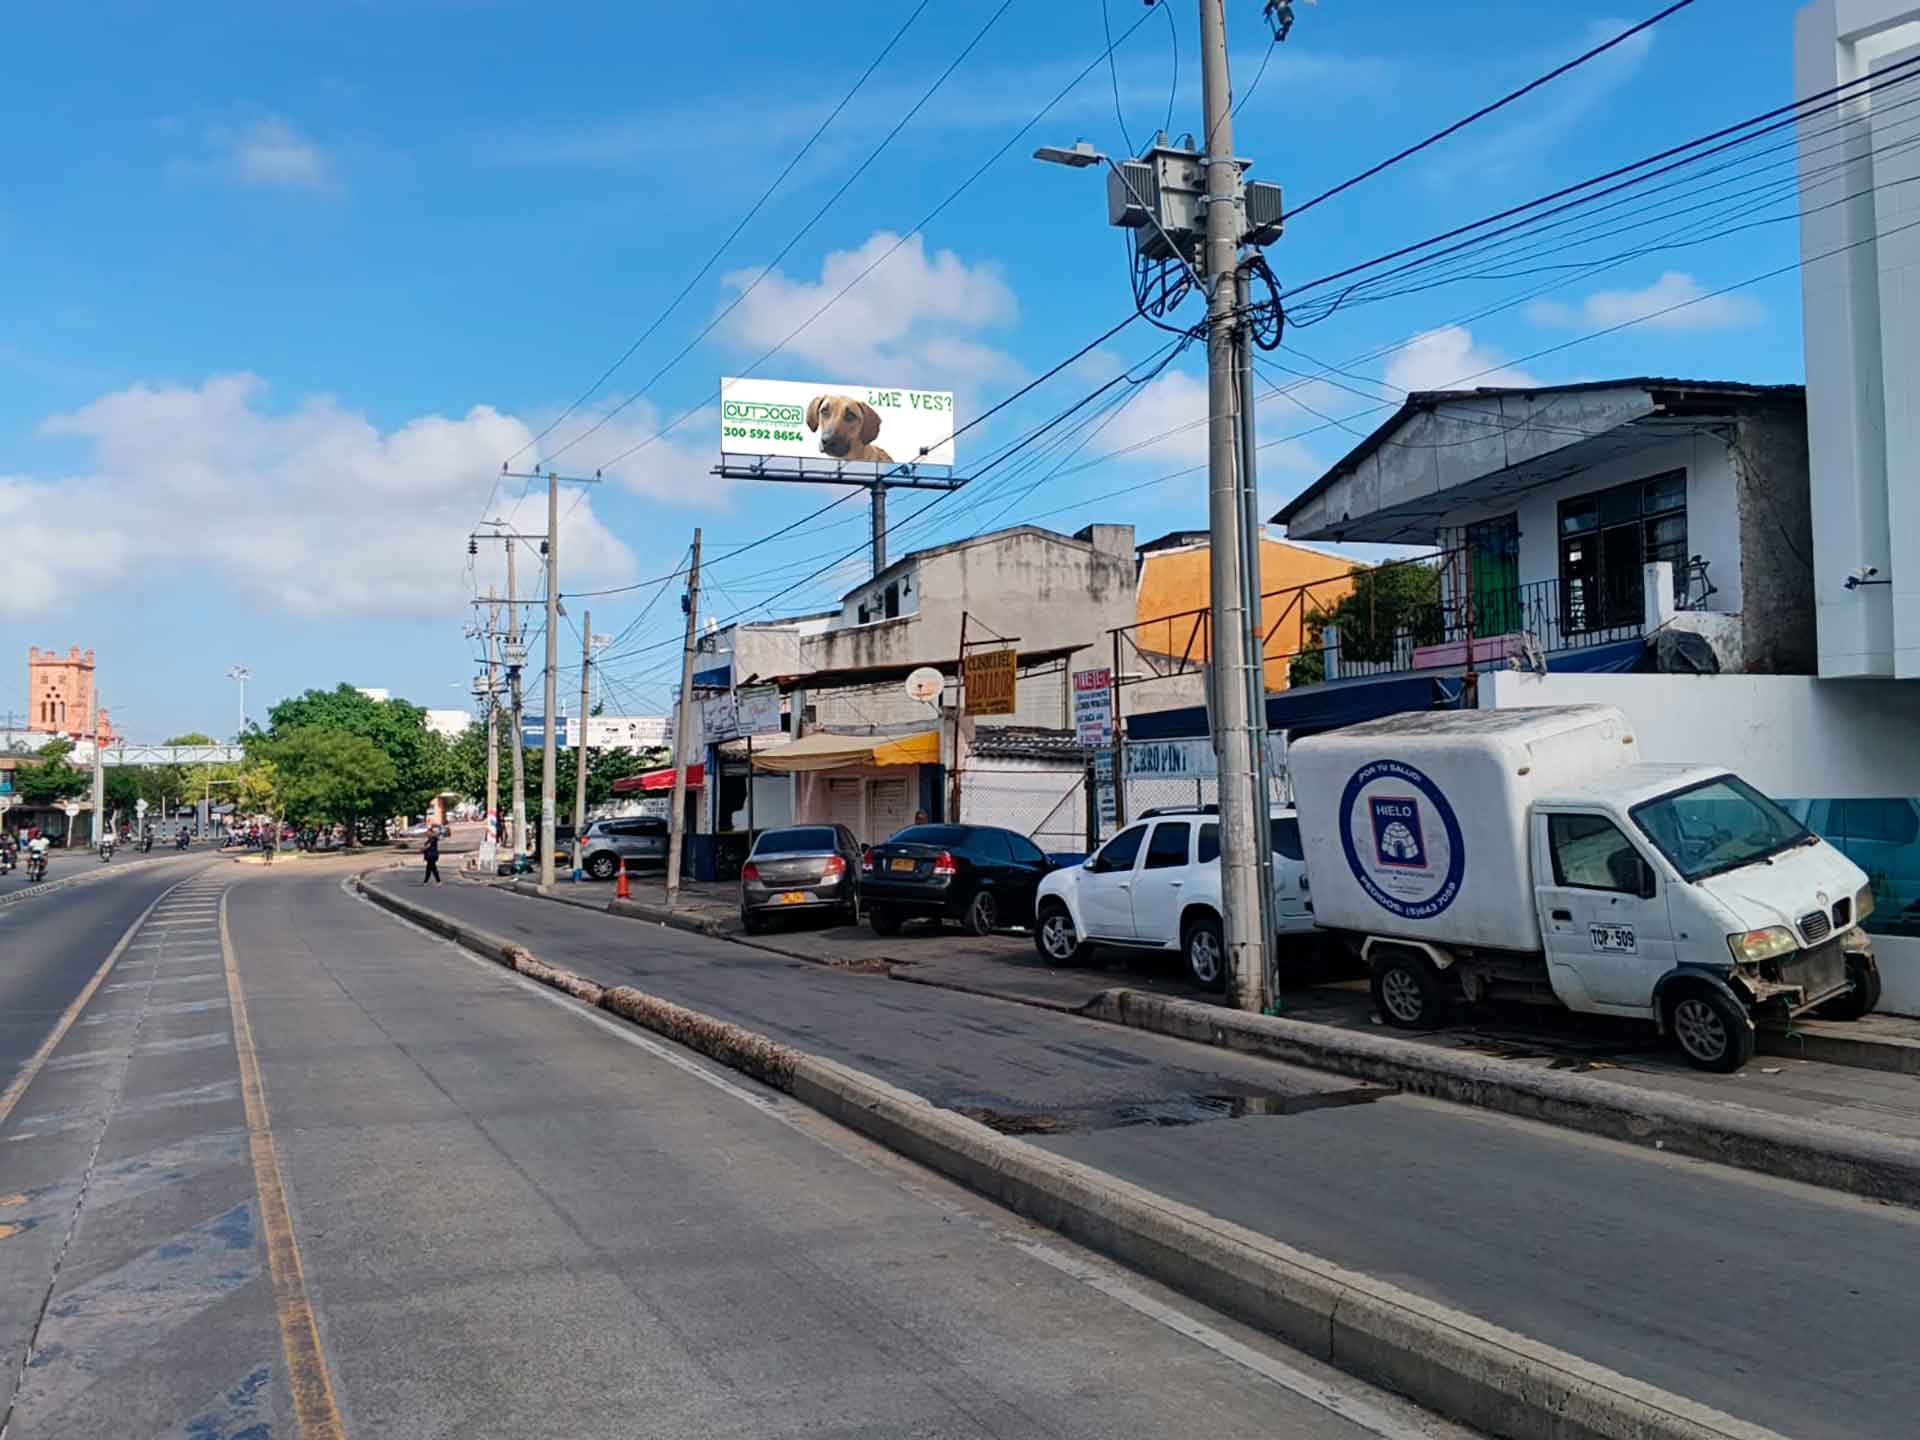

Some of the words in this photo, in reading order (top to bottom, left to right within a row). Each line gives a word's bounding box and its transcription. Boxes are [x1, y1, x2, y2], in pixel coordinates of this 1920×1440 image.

[867, 391, 901, 408] ¿ME
[909, 392, 953, 412] VES?
[726, 403, 801, 421] OUTDOOR
[723, 426, 747, 438] 300
[749, 428, 771, 440] 592
[1375, 804, 1412, 818] HIELO
